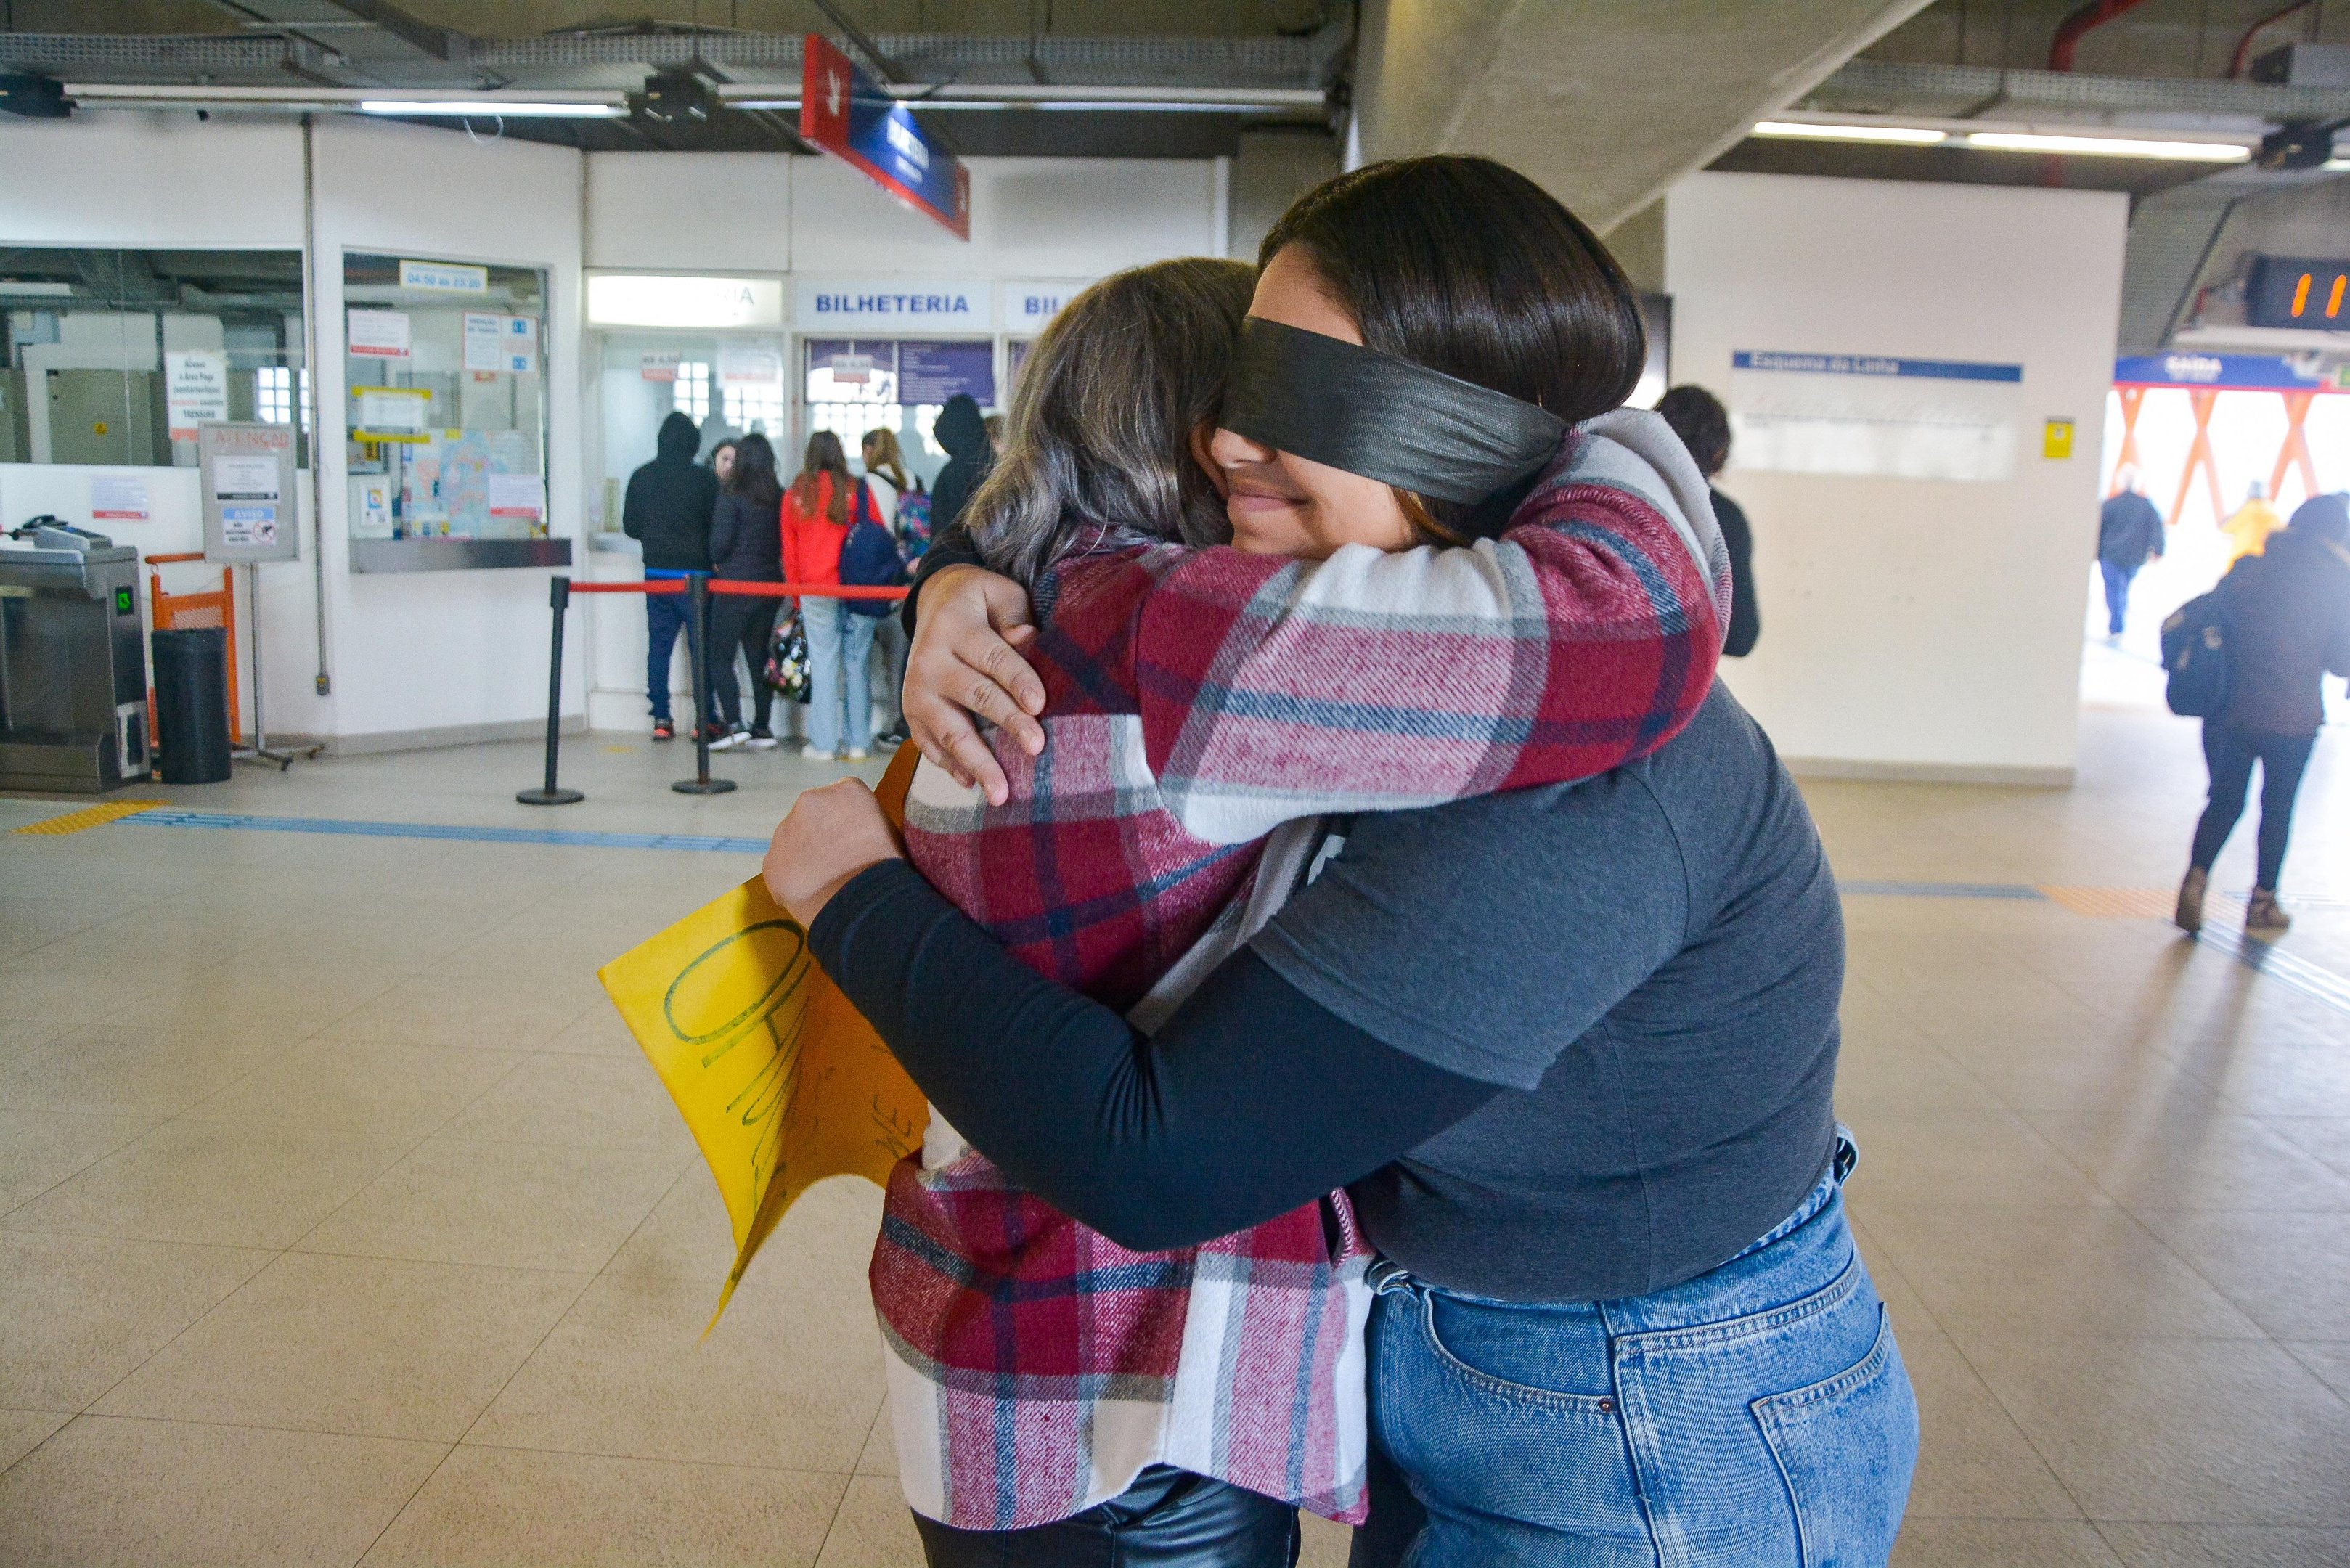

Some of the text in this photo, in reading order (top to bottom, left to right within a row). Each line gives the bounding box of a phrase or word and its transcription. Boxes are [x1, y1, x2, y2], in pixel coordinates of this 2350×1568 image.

[817, 293, 970, 313] BILHETERIA
[1025, 295, 1060, 314] BIL
[2291, 273, 2347, 319] 11
[234, 510, 265, 518] AVISO
